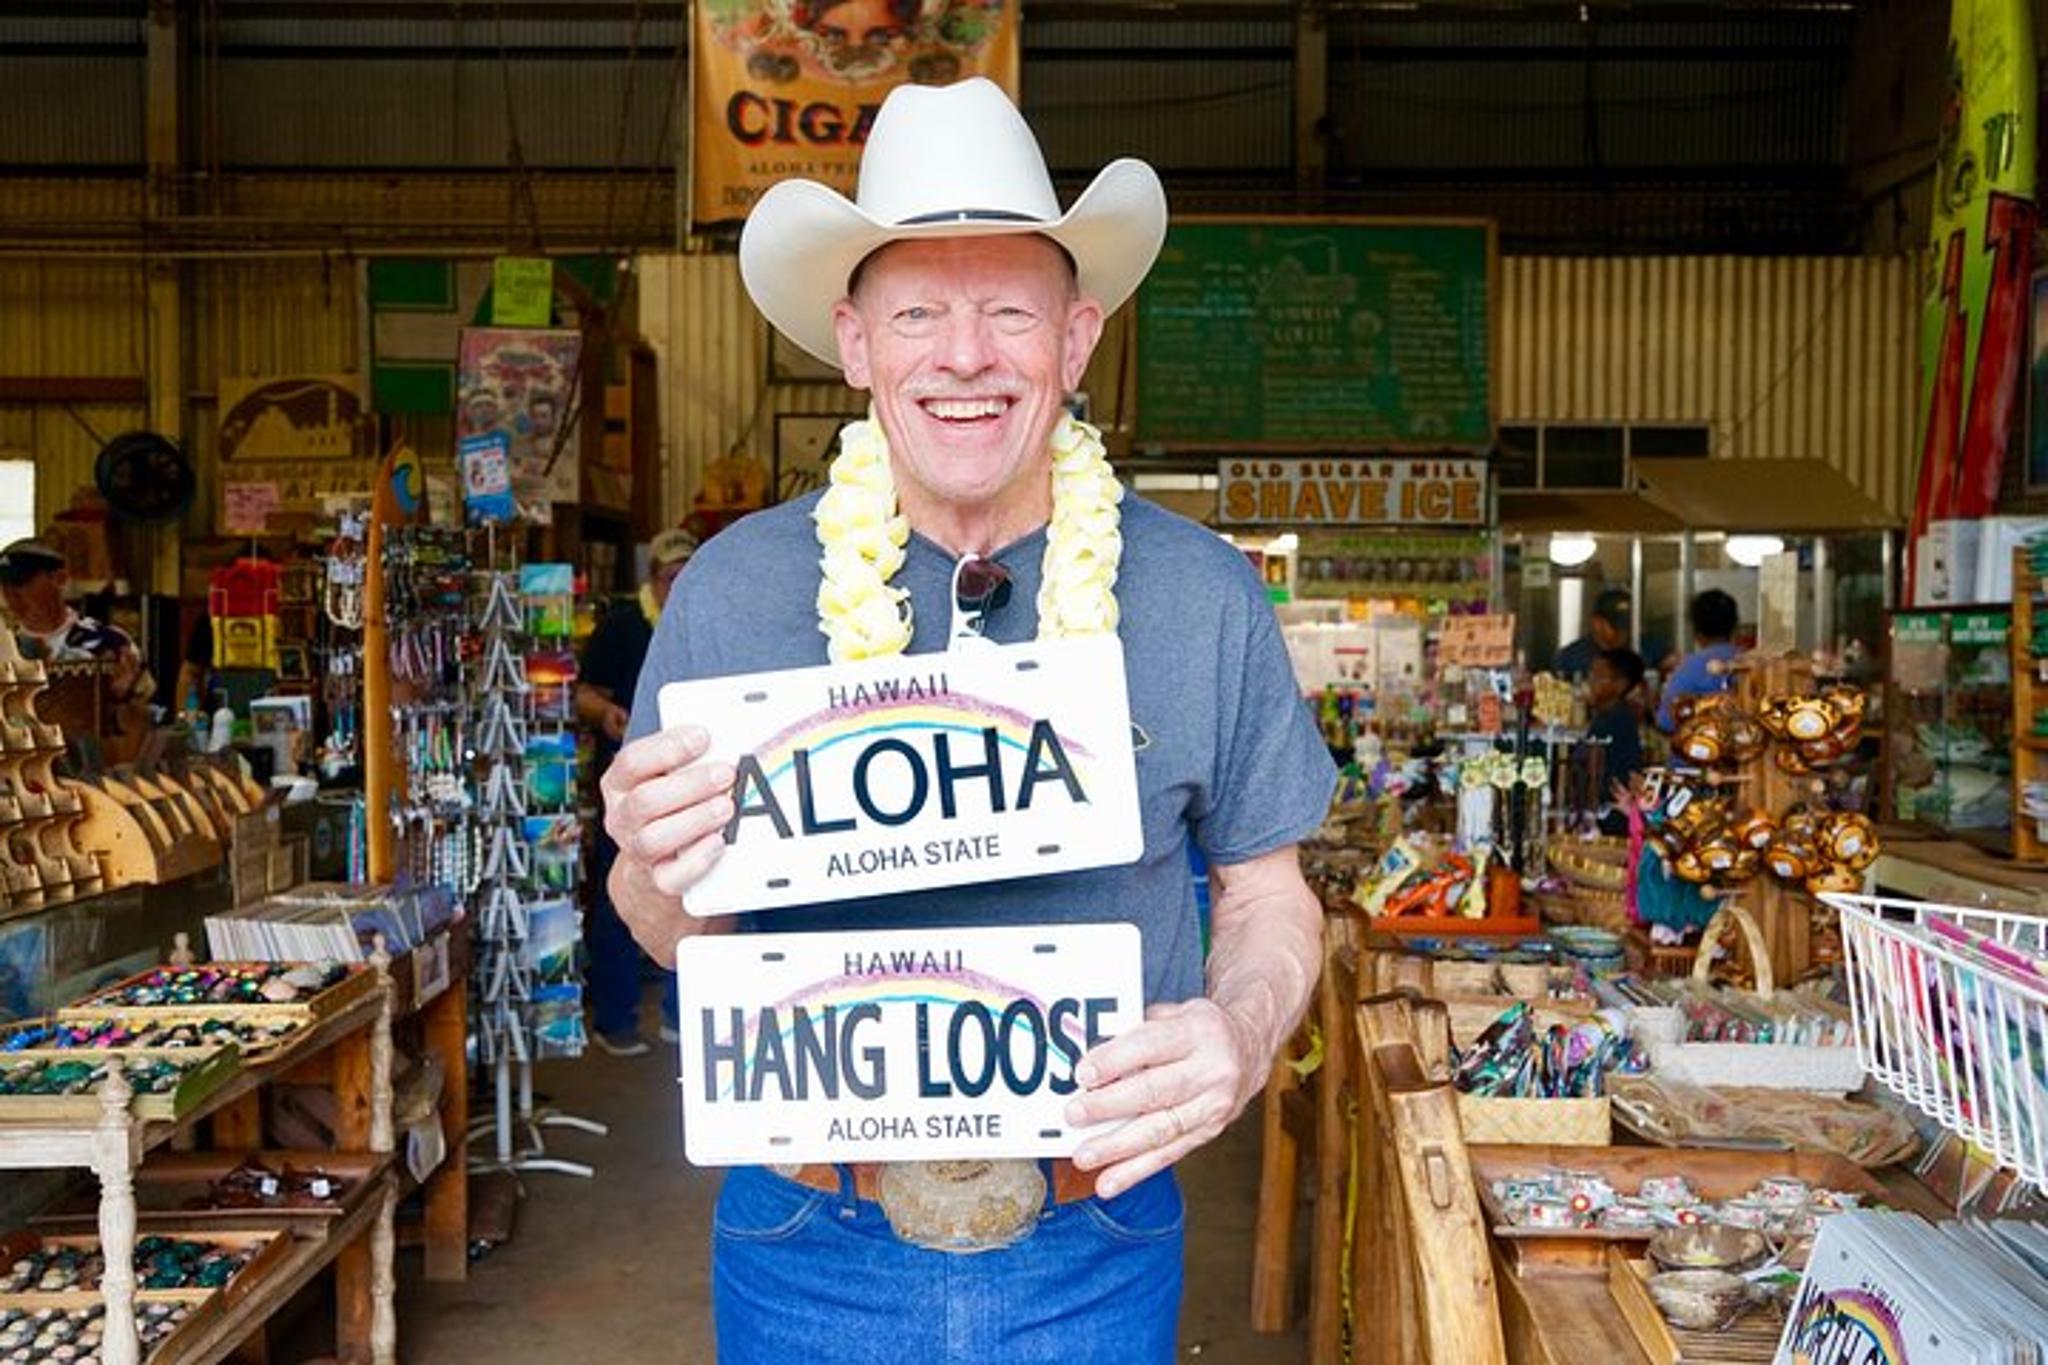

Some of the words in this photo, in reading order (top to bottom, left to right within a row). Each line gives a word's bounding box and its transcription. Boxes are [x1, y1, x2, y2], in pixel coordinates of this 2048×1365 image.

[1231, 463, 1283, 478] OLD
[1301, 463, 1393, 478] SUGAR
[1410, 463, 1475, 478] MILL
[1226, 481, 1388, 520] SHAVE
[1402, 481, 1479, 520] ICE
[828, 672, 949, 709] HAWAII
[722, 719, 1087, 846] ALOHA
[826, 849, 918, 878] ALOHA
[925, 835, 1001, 865] STATE
[843, 949, 964, 977] HAWAII
[702, 1003, 886, 1102] HANG
[827, 1117, 918, 1142] ALOHA
[926, 1114, 1001, 1139] STATE
